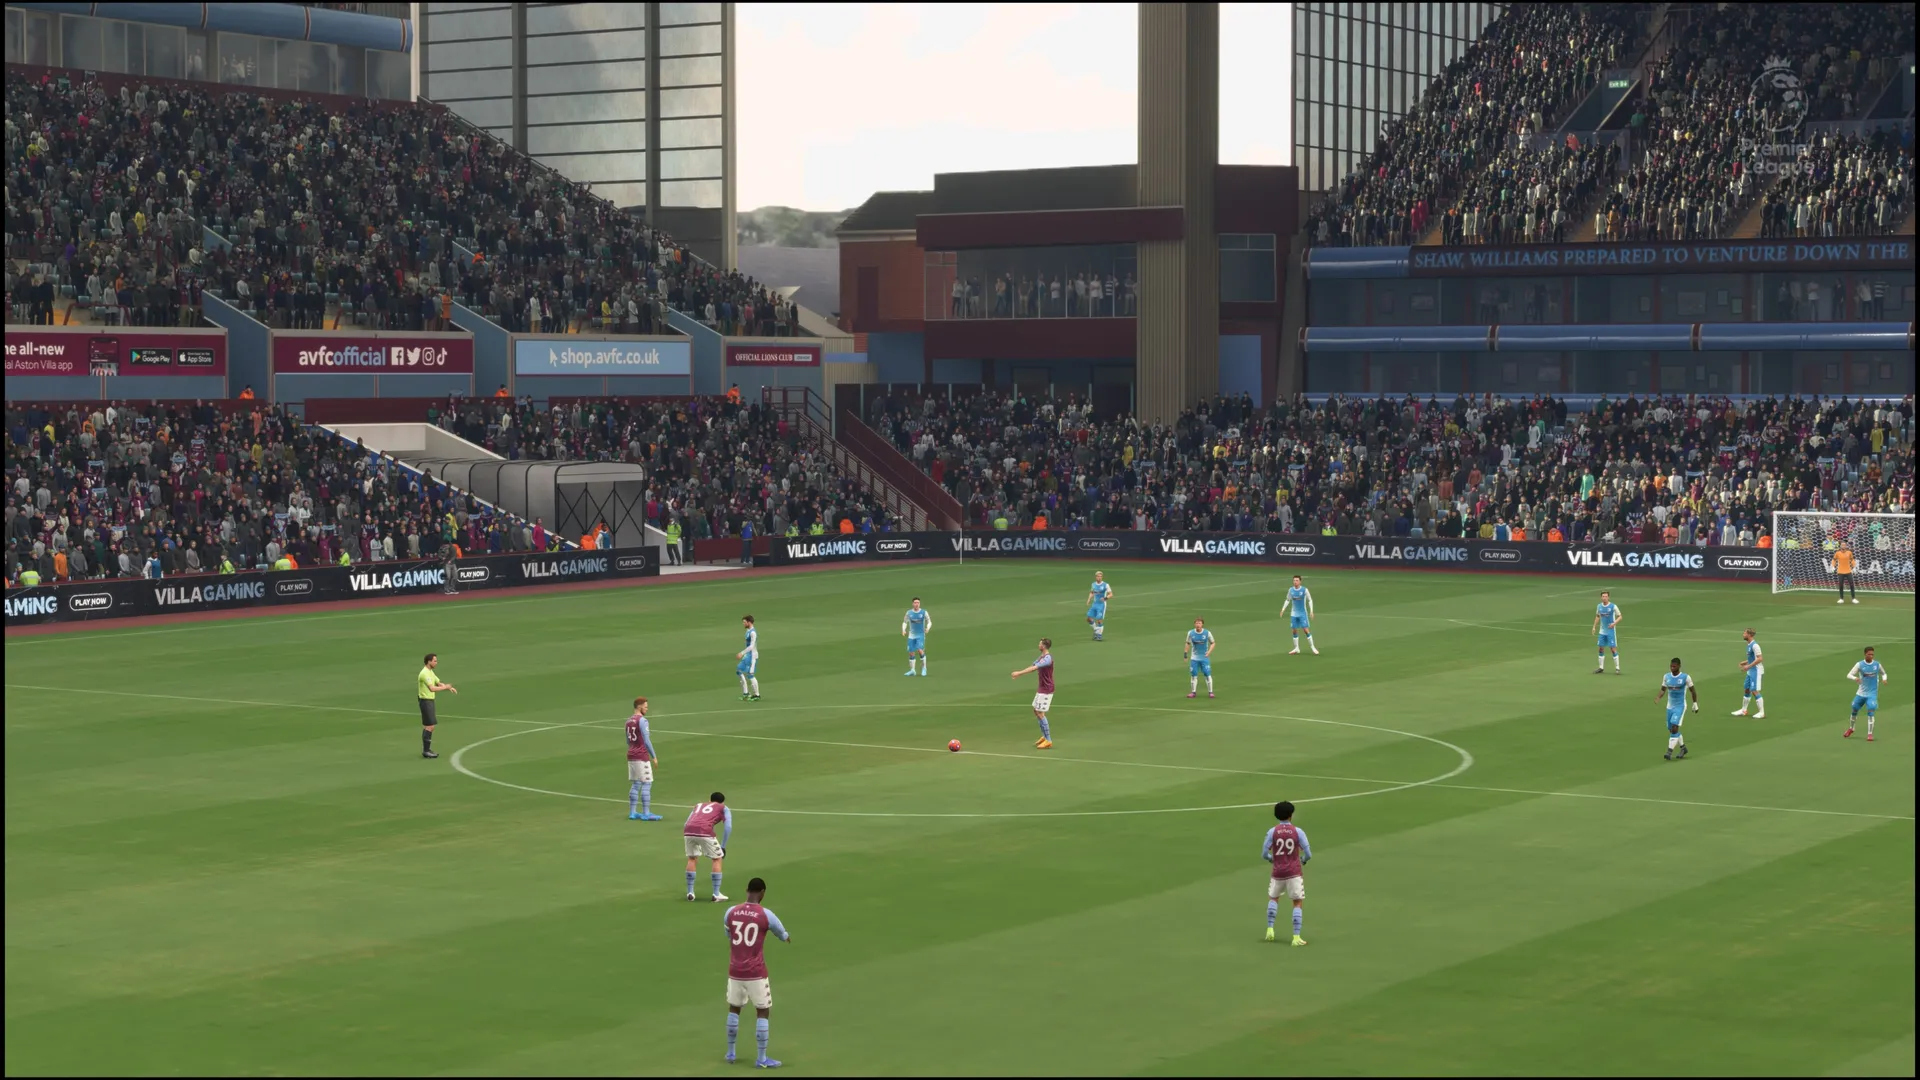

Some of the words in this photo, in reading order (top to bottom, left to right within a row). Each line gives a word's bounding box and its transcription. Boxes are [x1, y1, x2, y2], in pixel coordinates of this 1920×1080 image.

[1415, 252, 1464, 268] SHAW,
[1470, 250, 1559, 267] WILLIAMS
[1564, 248, 1656, 265] PREPARED
[1664, 247, 1688, 263] TO
[1694, 246, 1788, 263] VENTURE
[1794, 243, 1860, 260] DOWN
[1867, 243, 1909, 259] THE
[19, 341, 65, 356] all-new
[299, 345, 386, 366] avfcofficial
[560, 347, 660, 369] shop.avfc.co.uk
[15, 360, 39, 370] Aston
[41, 360, 57, 370] Villa
[57, 362, 74, 372] app
[1743, 559, 1762, 567] NOW
[472, 570, 485, 578] NOW
[280, 584, 294, 592] PLAY
[293, 583, 308, 591] NOW
[75, 599, 90, 607] PLAY
[90, 598, 107, 606] NOW
[695, 802, 716, 814] 16
[1275, 838, 1295, 856] 29
[733, 909, 759, 918] HAUSE
[731, 920, 759, 947] 30
